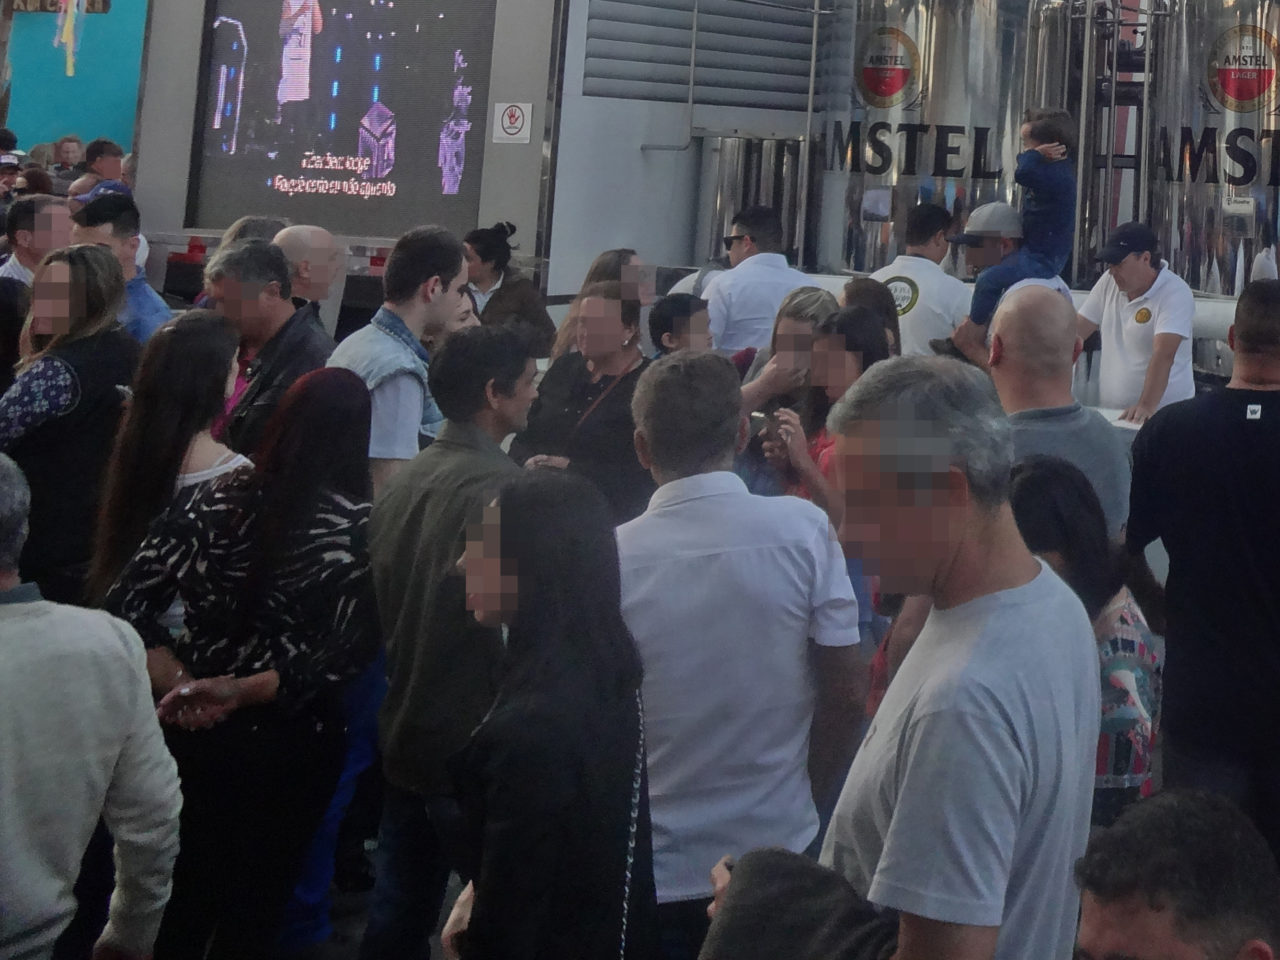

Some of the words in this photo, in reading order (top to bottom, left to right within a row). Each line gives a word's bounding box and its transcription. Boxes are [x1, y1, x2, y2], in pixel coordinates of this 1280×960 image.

[869, 55, 906, 66] AMSTEL
[1223, 55, 1268, 66] AMSTEL
[1231, 71, 1258, 80] LAGER
